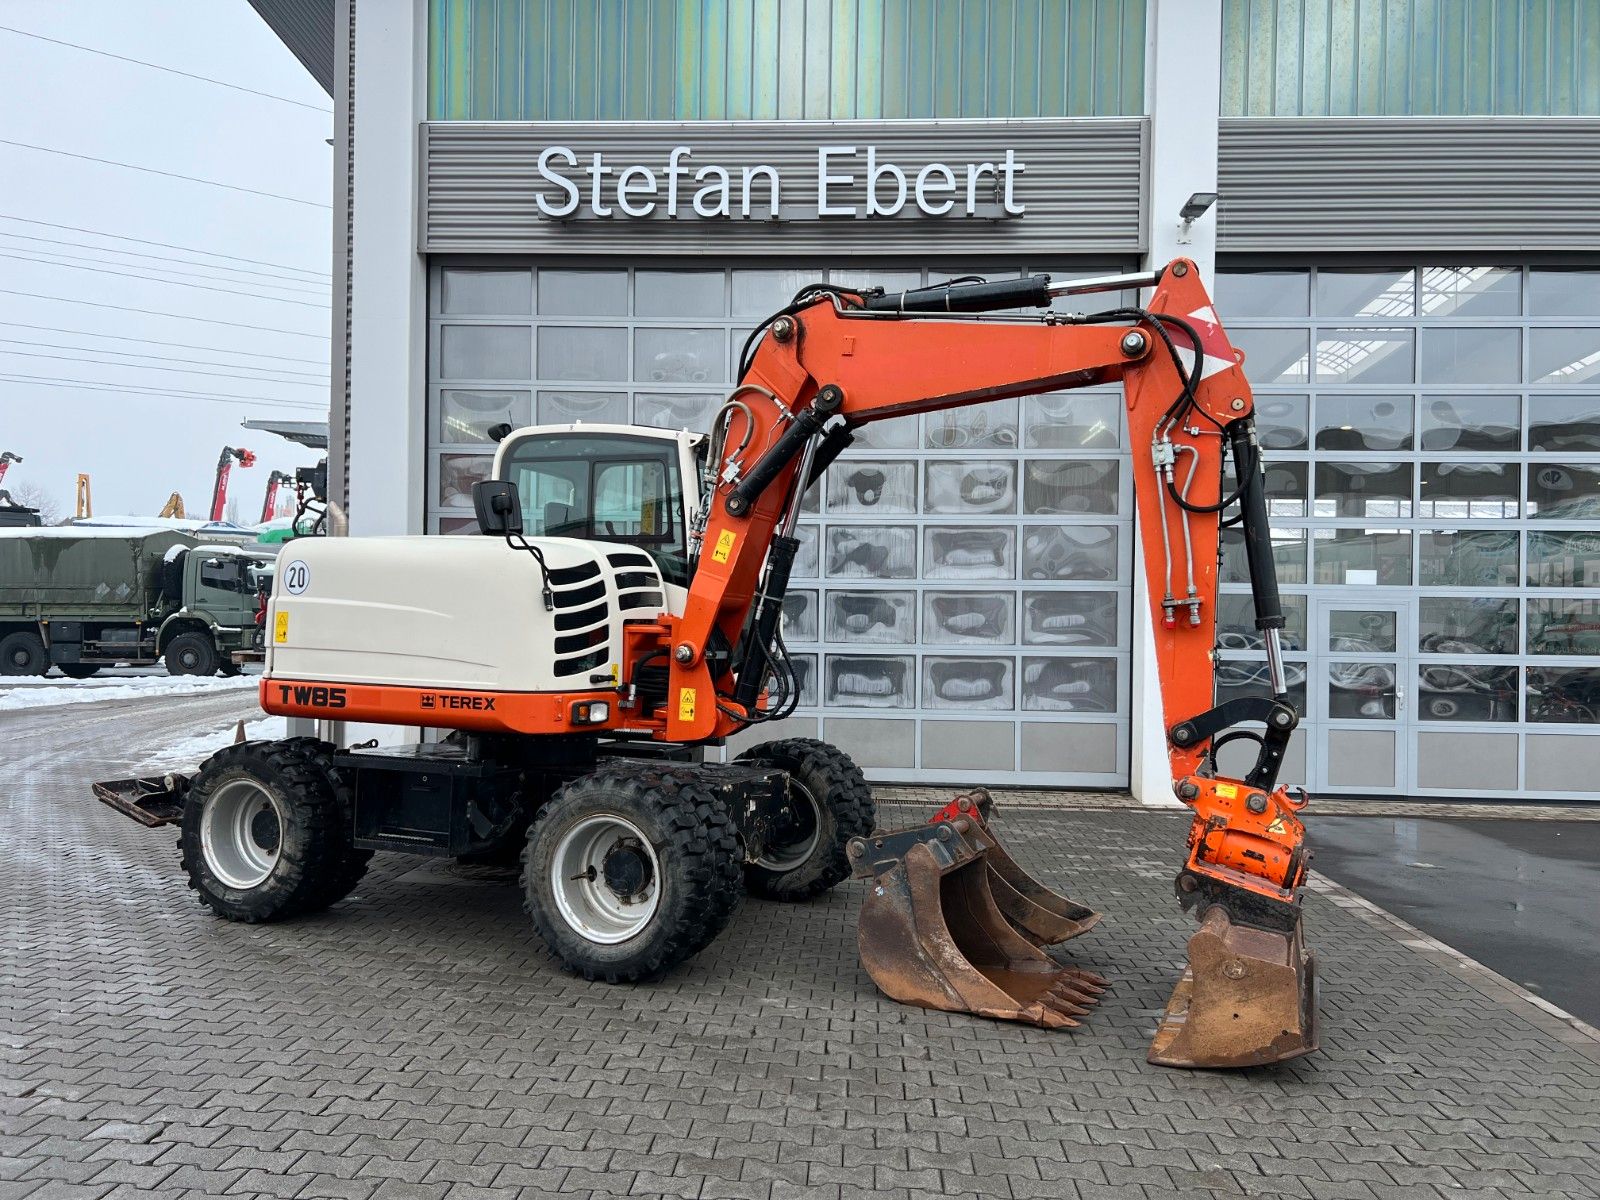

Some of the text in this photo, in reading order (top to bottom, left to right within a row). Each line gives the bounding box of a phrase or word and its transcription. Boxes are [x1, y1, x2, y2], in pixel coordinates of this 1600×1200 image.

[535, 145, 1027, 219] Stefan Ebert
[289, 566, 306, 589] 20
[278, 684, 347, 708] TW85
[438, 694, 496, 711] TEREX
